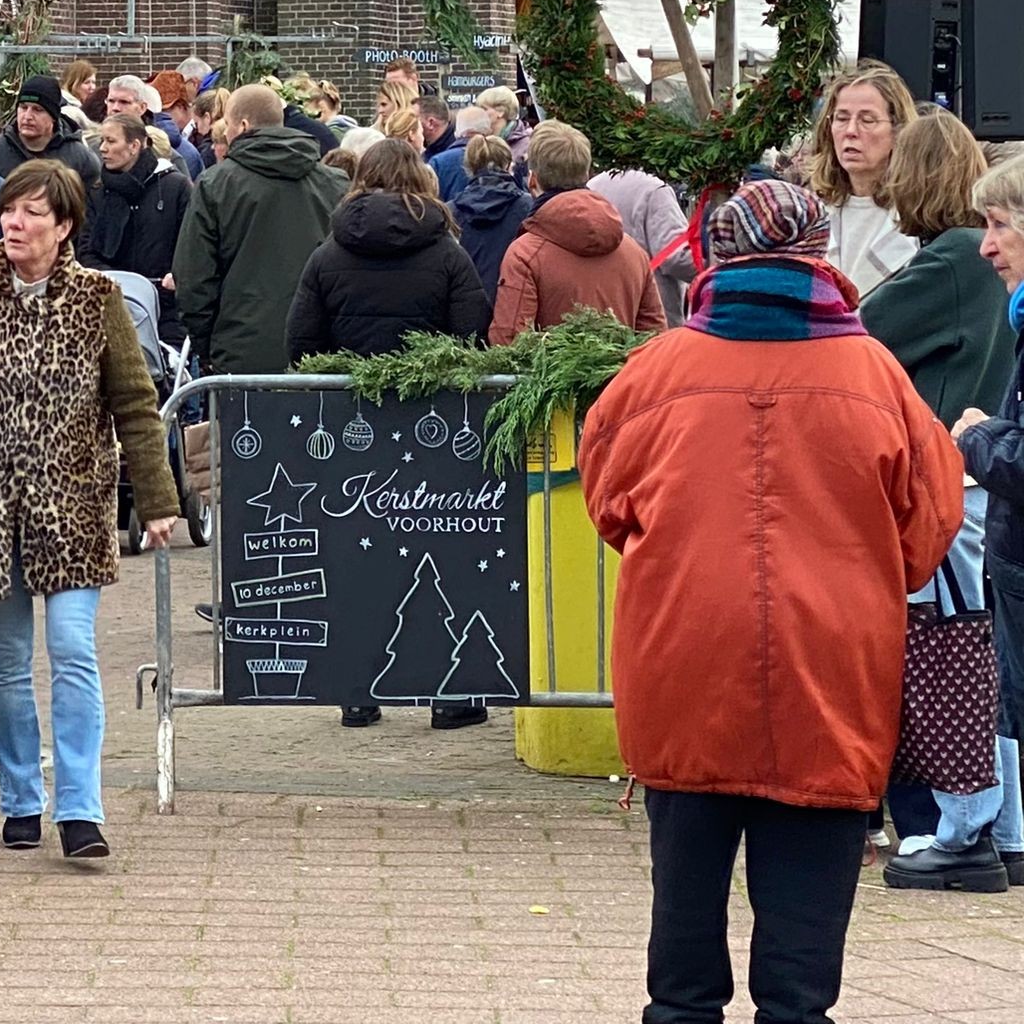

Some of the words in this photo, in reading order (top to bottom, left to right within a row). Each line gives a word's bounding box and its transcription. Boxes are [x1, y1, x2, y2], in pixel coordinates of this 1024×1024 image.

[320, 469, 507, 518] Kerstmarkt
[386, 517, 506, 533] VOORHOUT
[248, 536, 313, 551] welkom
[239, 588, 252, 600] 10
[255, 581, 318, 597] december
[236, 623, 310, 639] kerkplein
